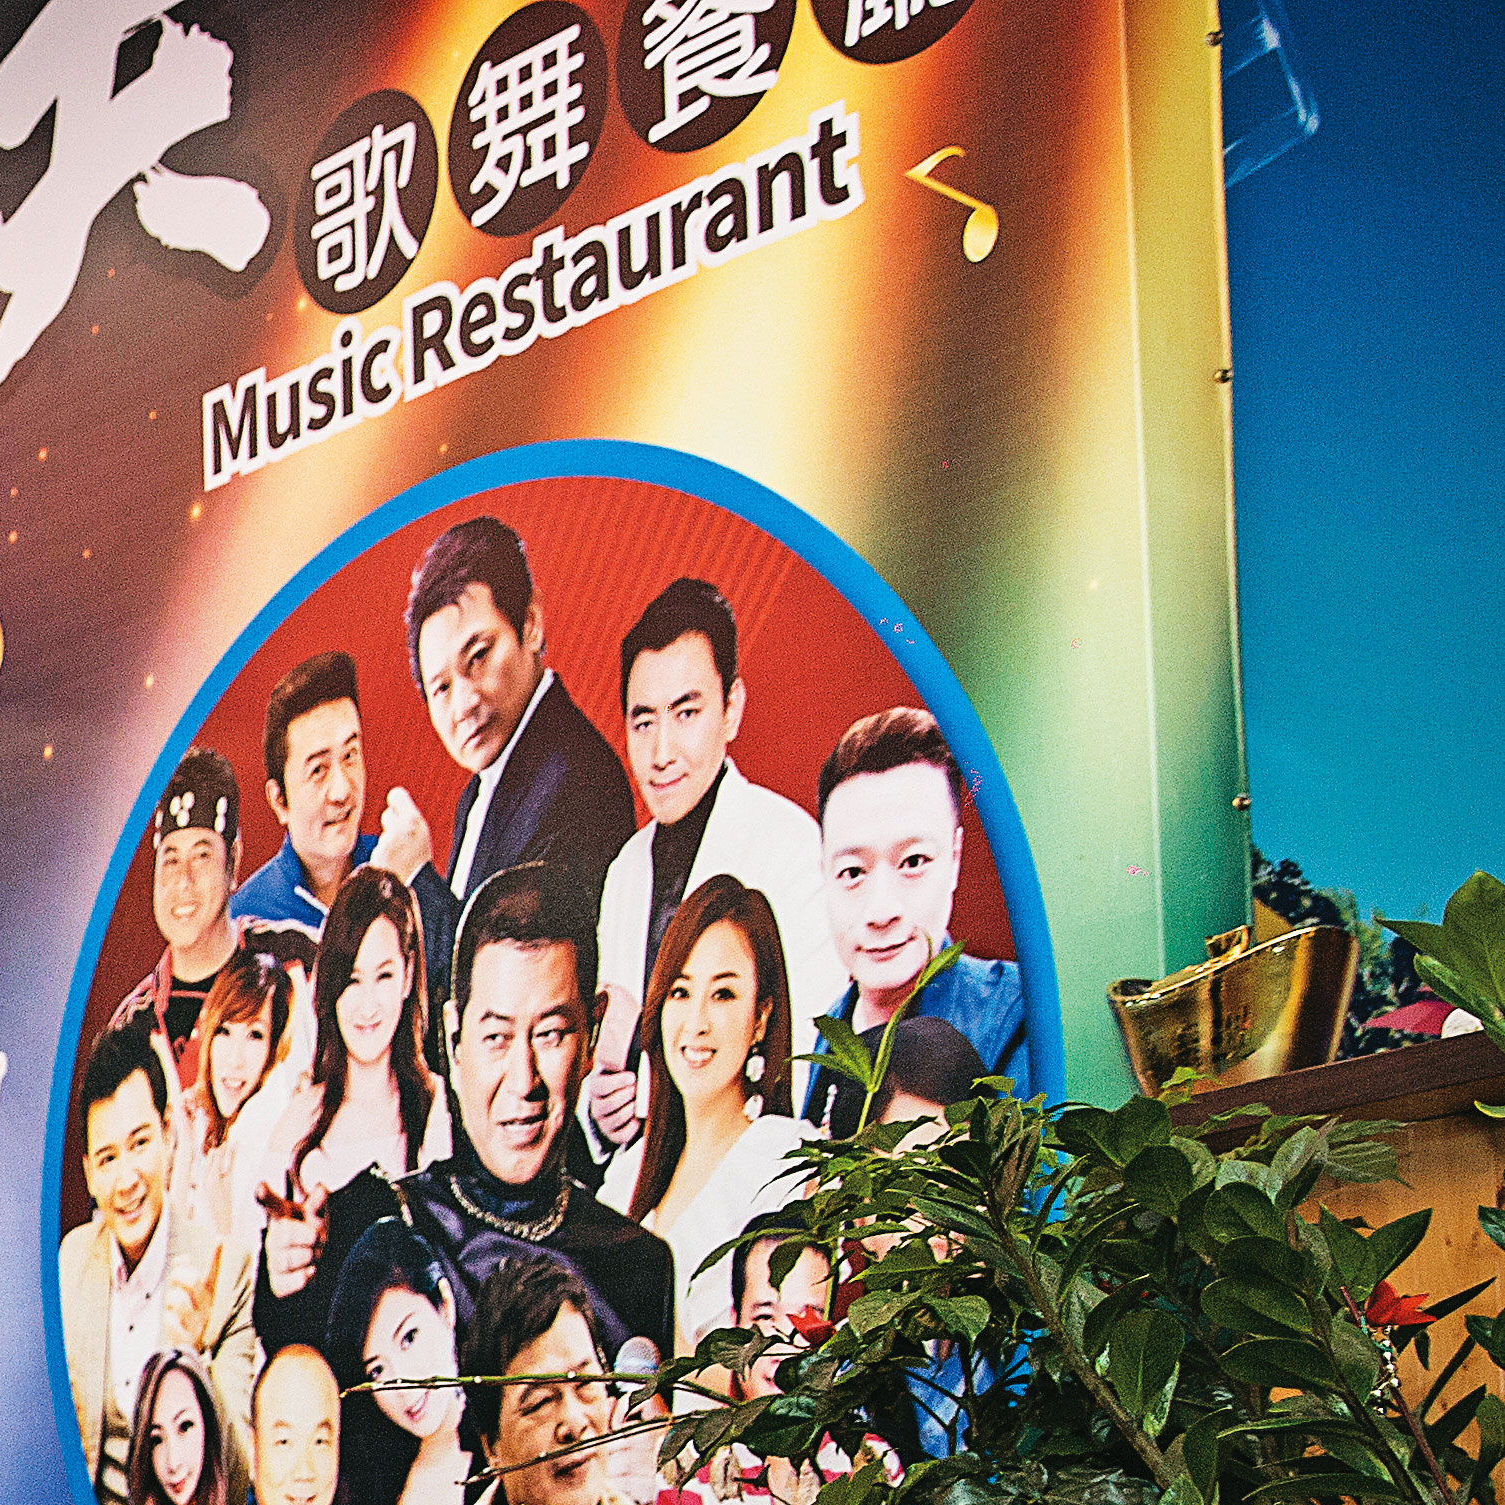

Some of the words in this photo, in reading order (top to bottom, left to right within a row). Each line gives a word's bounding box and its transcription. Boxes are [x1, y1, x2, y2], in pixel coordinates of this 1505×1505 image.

[206, 324, 397, 482] Music
[406, 112, 856, 392] Restaurant
[310, 0, 956, 294] 歌舞餐
